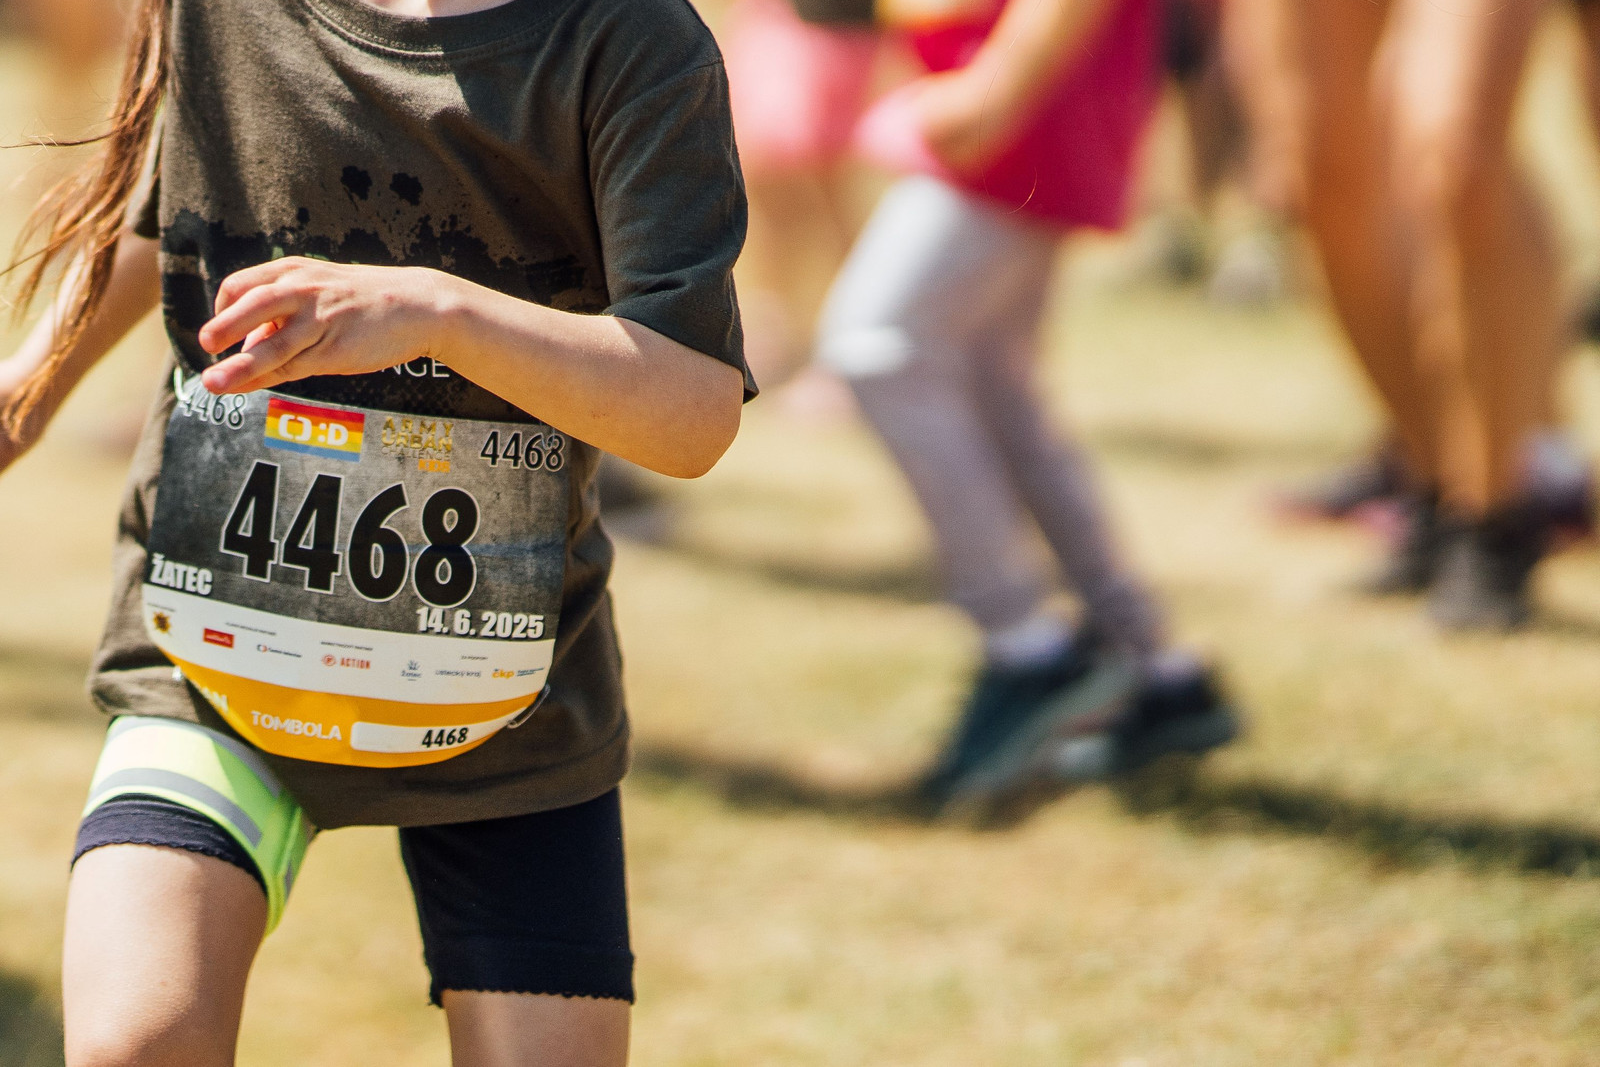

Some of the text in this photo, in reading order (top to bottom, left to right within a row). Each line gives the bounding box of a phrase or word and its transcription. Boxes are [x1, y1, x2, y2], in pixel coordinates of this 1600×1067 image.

[381, 429, 453, 452] URBAN
[383, 416, 455, 437] ARMY
[480, 428, 566, 473] 4468
[220, 459, 481, 609] 4468
[150, 552, 213, 596] ŽATEC
[416, 606, 544, 639] 14. 6. 2025
[340, 657, 371, 670] ACTION
[251, 710, 343, 741] TOMBOLA
[421, 727, 469, 748] 4468
